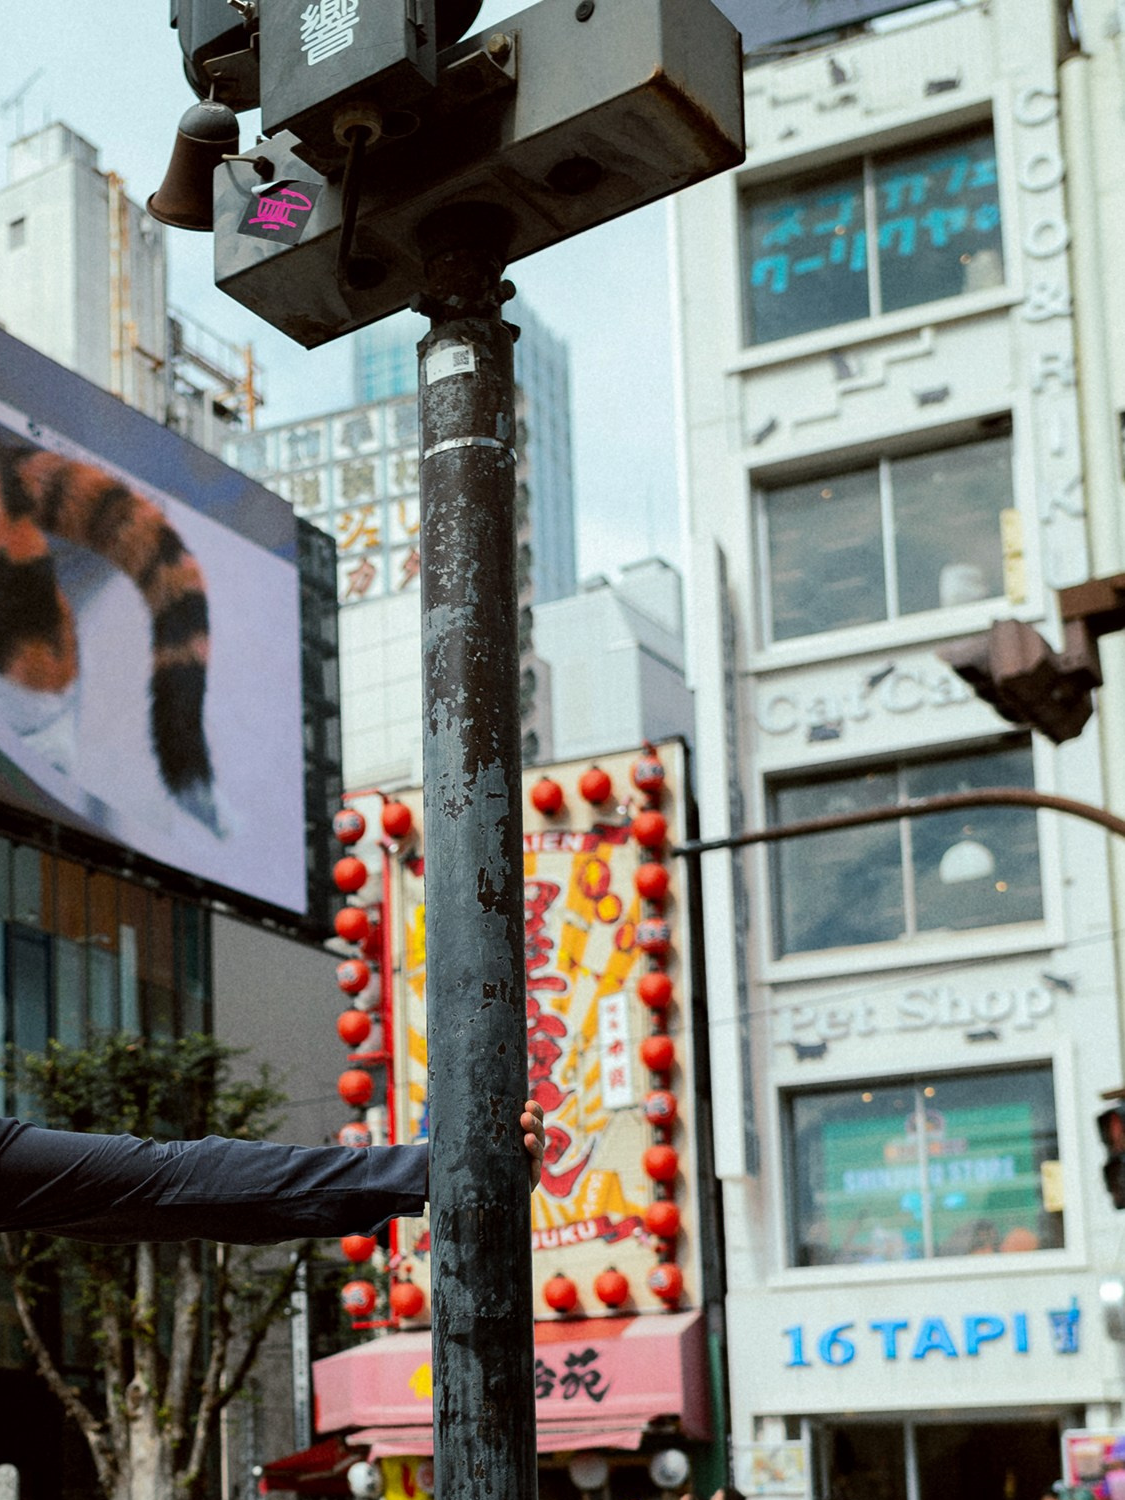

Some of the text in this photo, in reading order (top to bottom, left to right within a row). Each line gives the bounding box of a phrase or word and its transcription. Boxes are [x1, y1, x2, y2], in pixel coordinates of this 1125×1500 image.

[896, 986, 1057, 1033] Shop
[783, 1311, 1031, 1368] 16 TAPI
